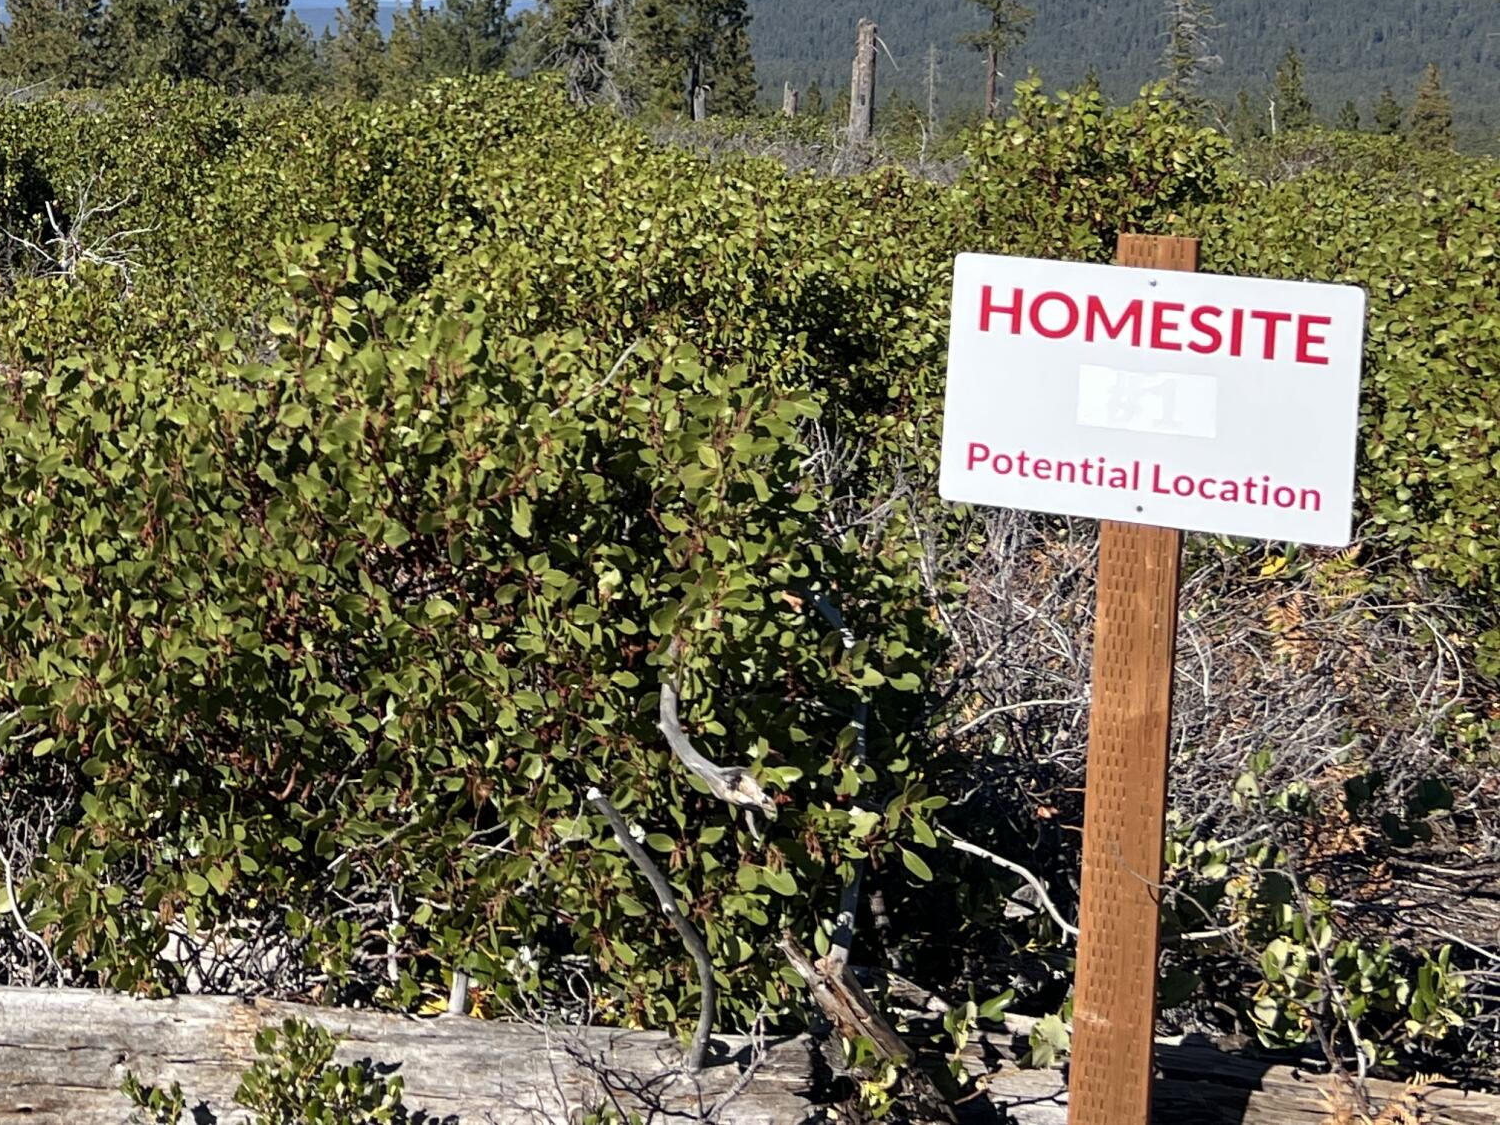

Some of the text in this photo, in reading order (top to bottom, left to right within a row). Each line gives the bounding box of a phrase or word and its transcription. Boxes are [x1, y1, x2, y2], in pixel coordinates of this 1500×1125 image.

[978, 284, 1333, 366] HOMESITE
[966, 441, 1322, 512] Potential Location
